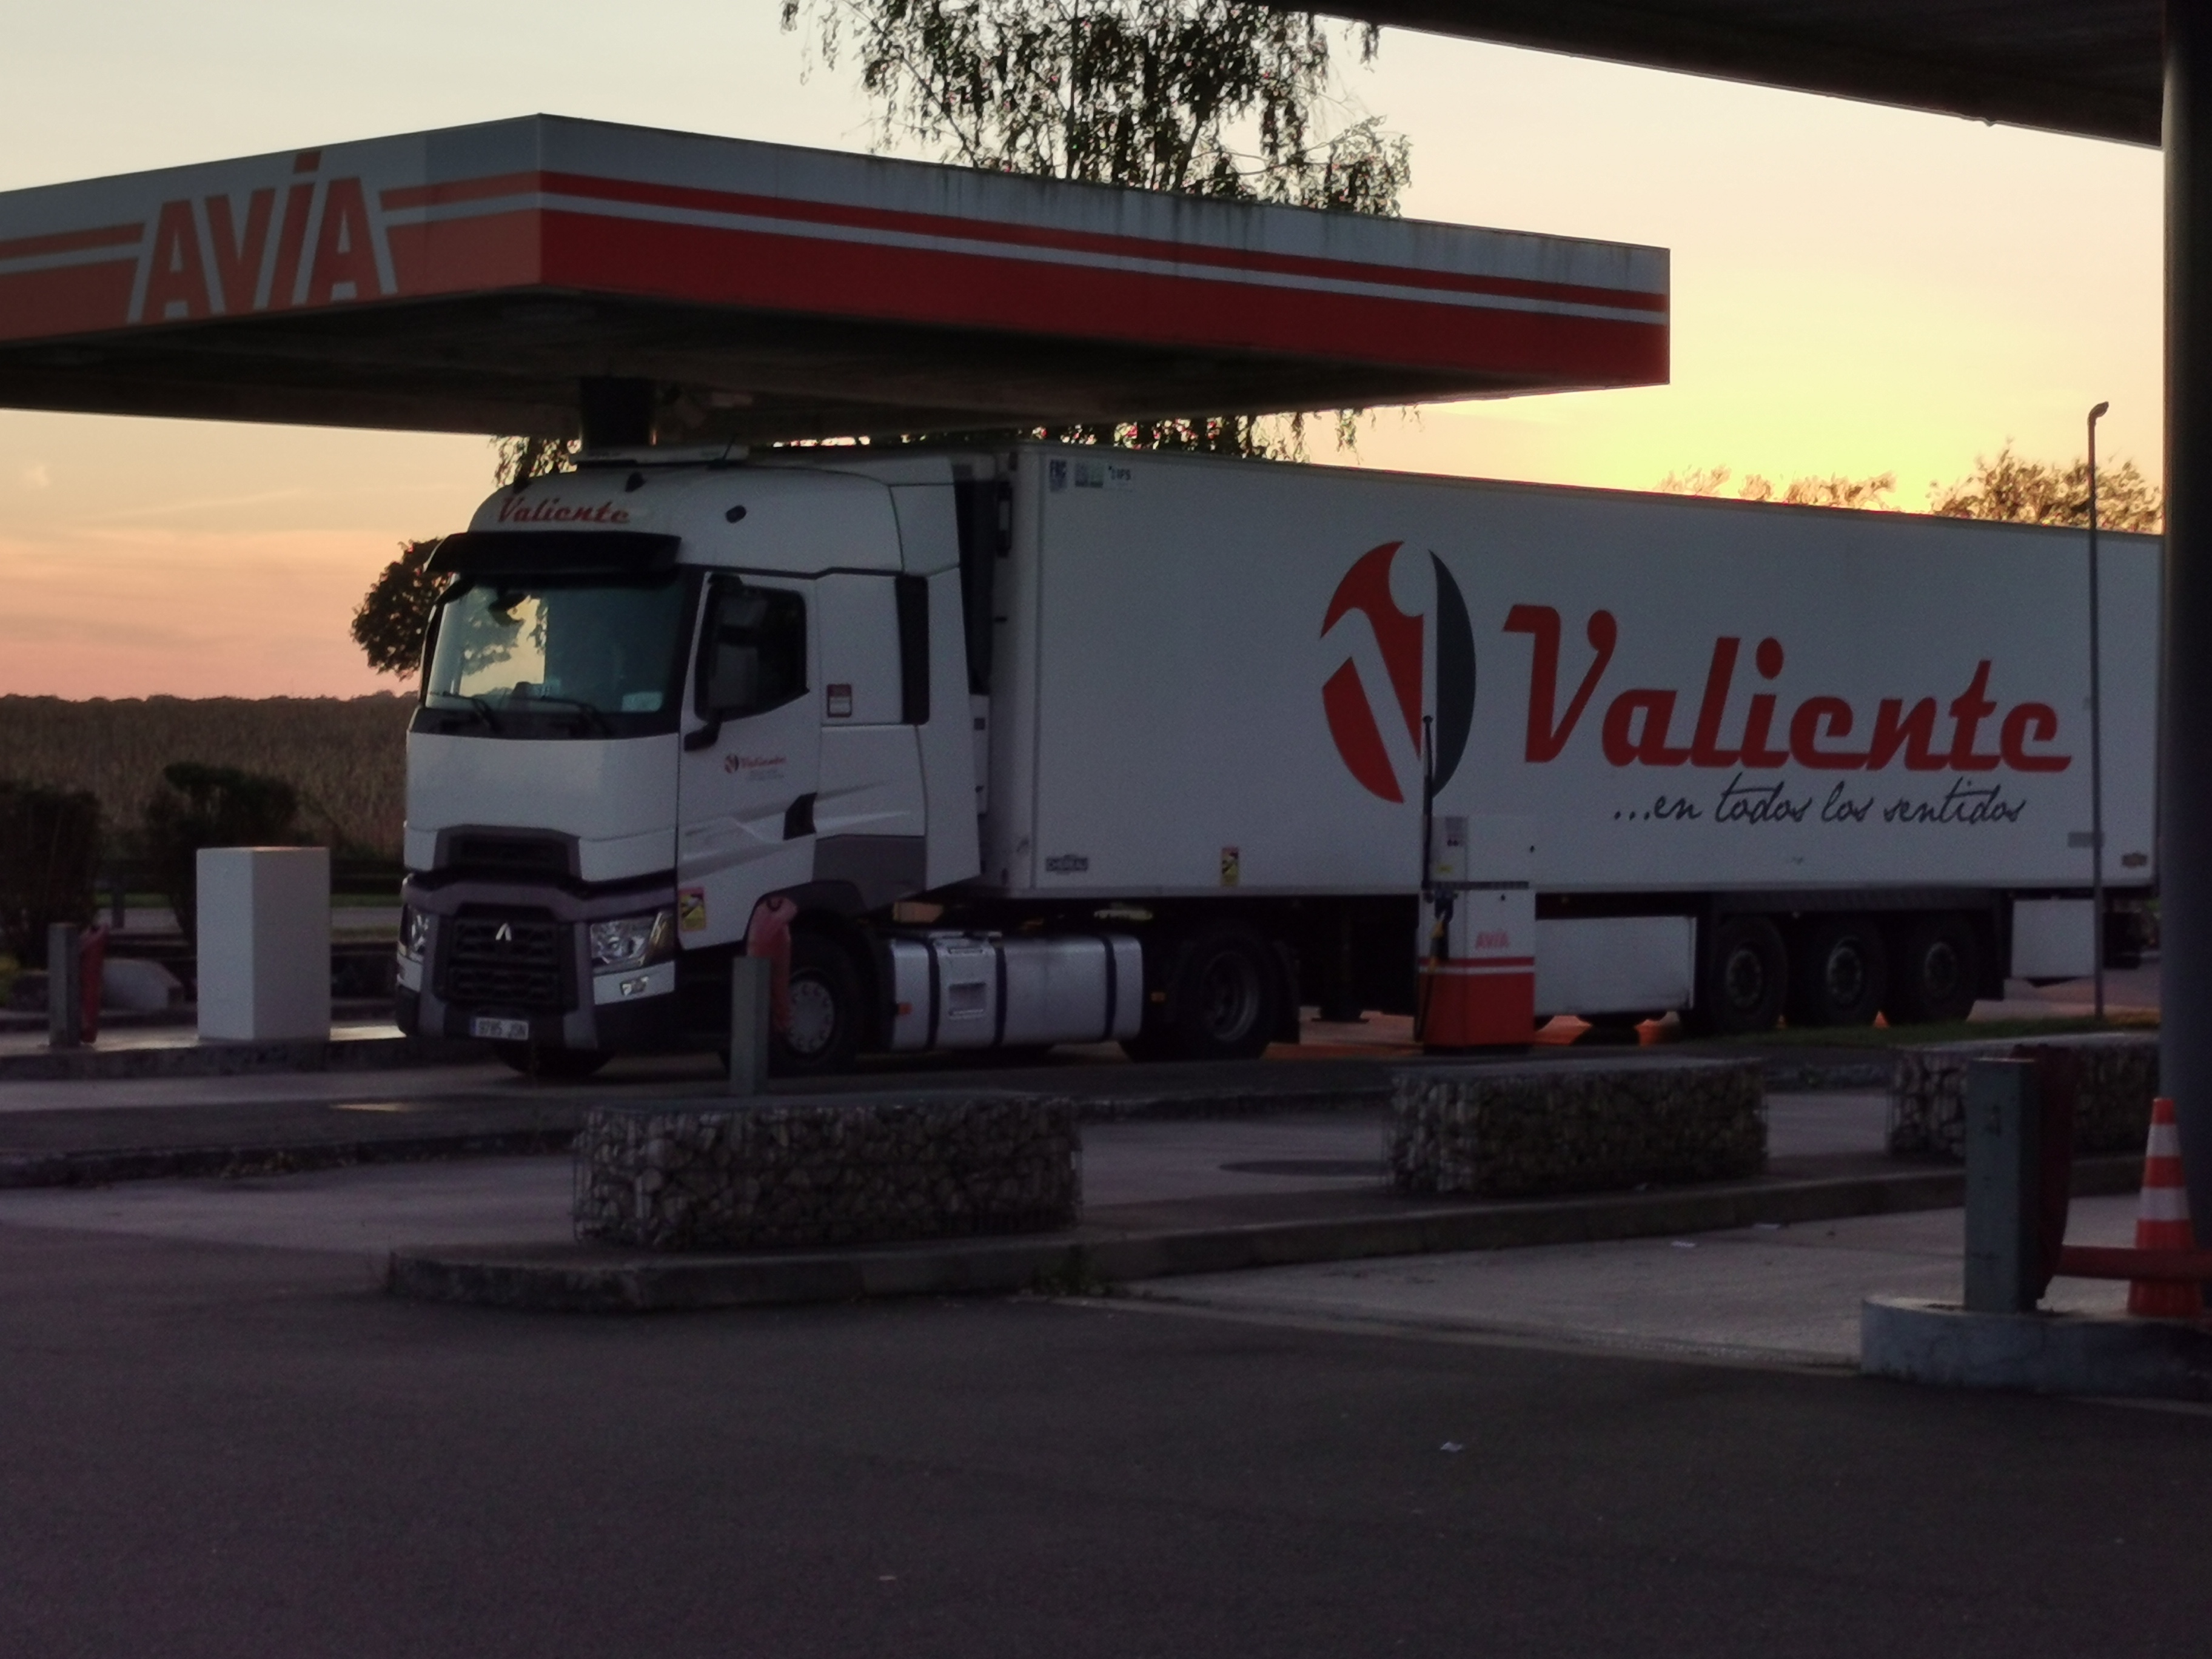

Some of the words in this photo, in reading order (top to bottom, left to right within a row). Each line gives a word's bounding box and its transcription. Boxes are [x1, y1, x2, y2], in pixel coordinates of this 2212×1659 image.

[498, 497, 630, 523] Valiente
[1502, 603, 2073, 772] Valiente
[1713, 771, 1815, 824] todos
[1820, 780, 1877, 823] los
[1883, 776, 2028, 824] sentidos
